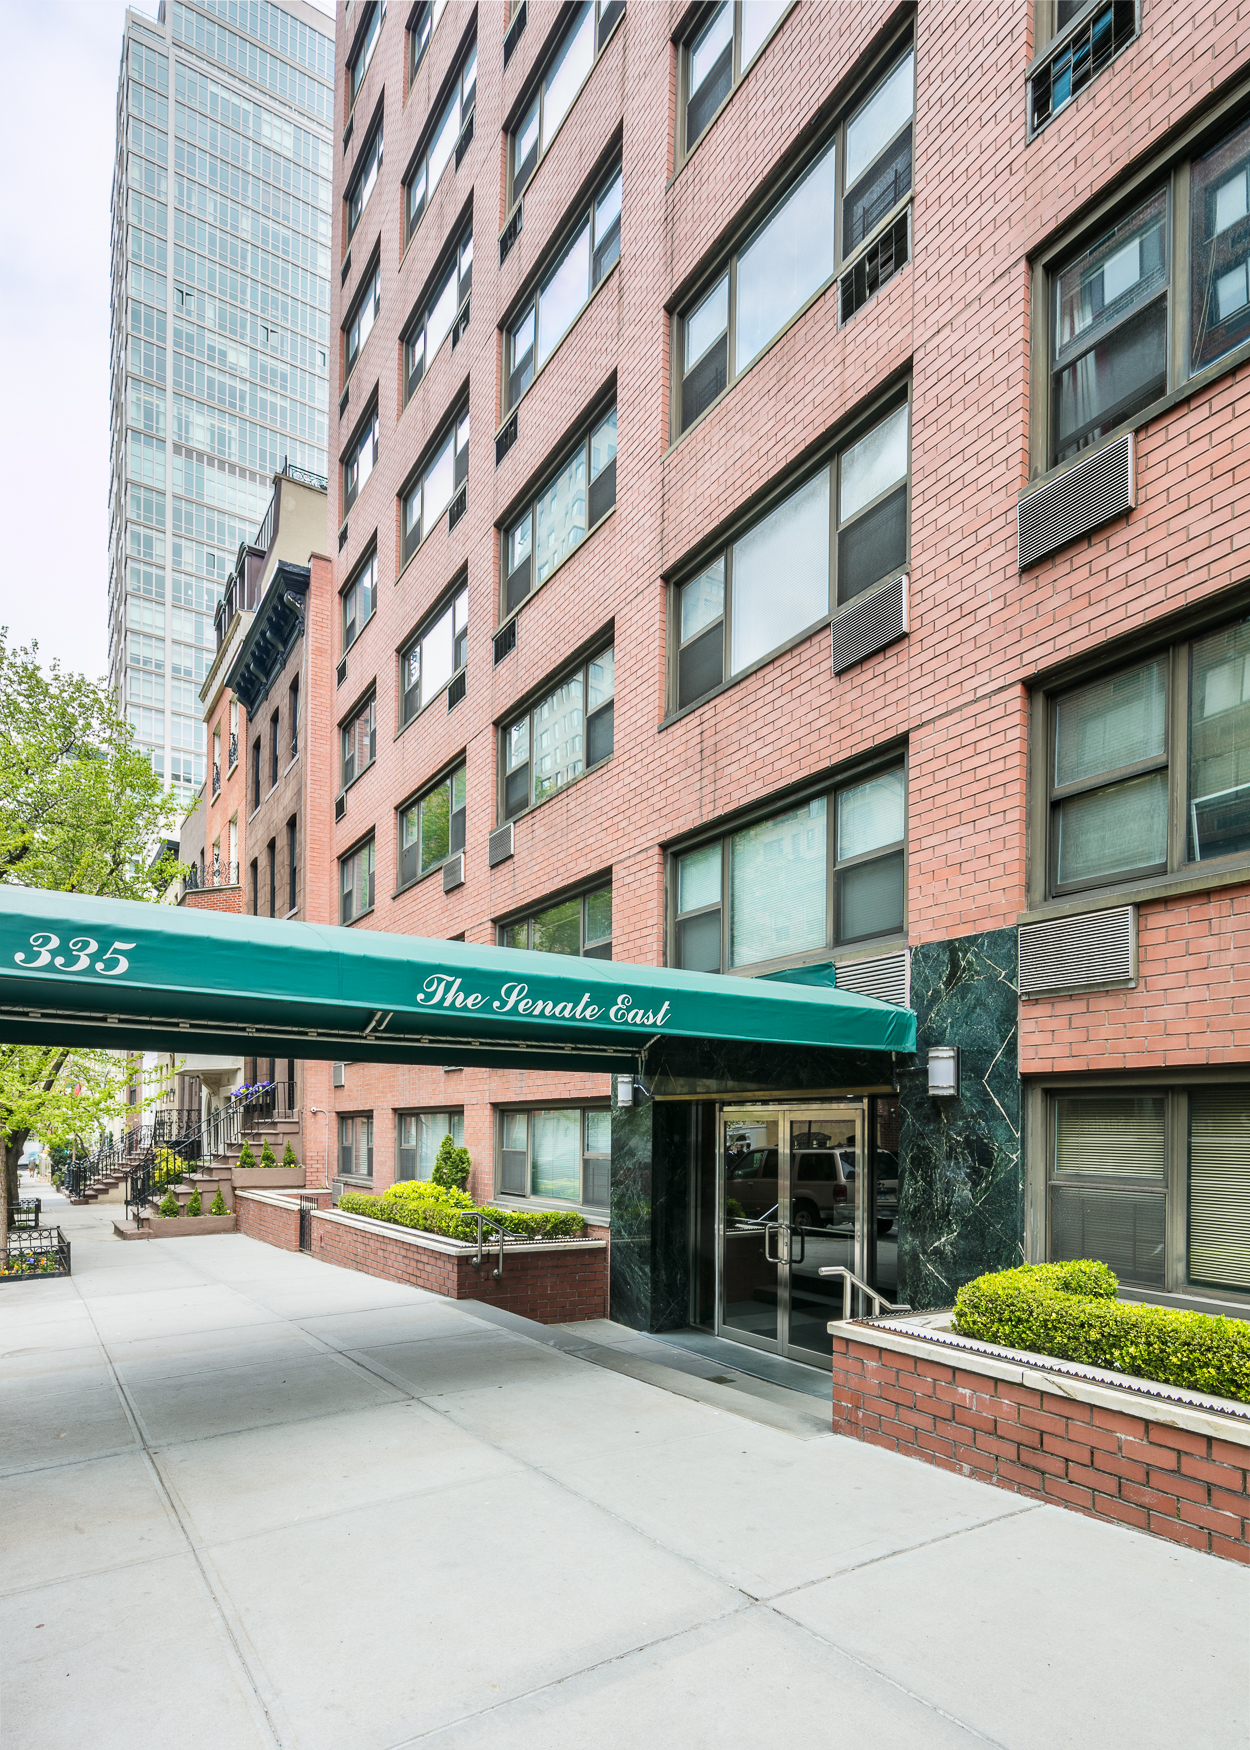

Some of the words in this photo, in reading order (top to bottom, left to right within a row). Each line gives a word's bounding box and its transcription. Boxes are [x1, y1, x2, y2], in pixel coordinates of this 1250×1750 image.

[14, 932, 137, 976] 335
[416, 973, 490, 1010] The
[492, 982, 606, 1021] Senate
[609, 993, 672, 1026] East
